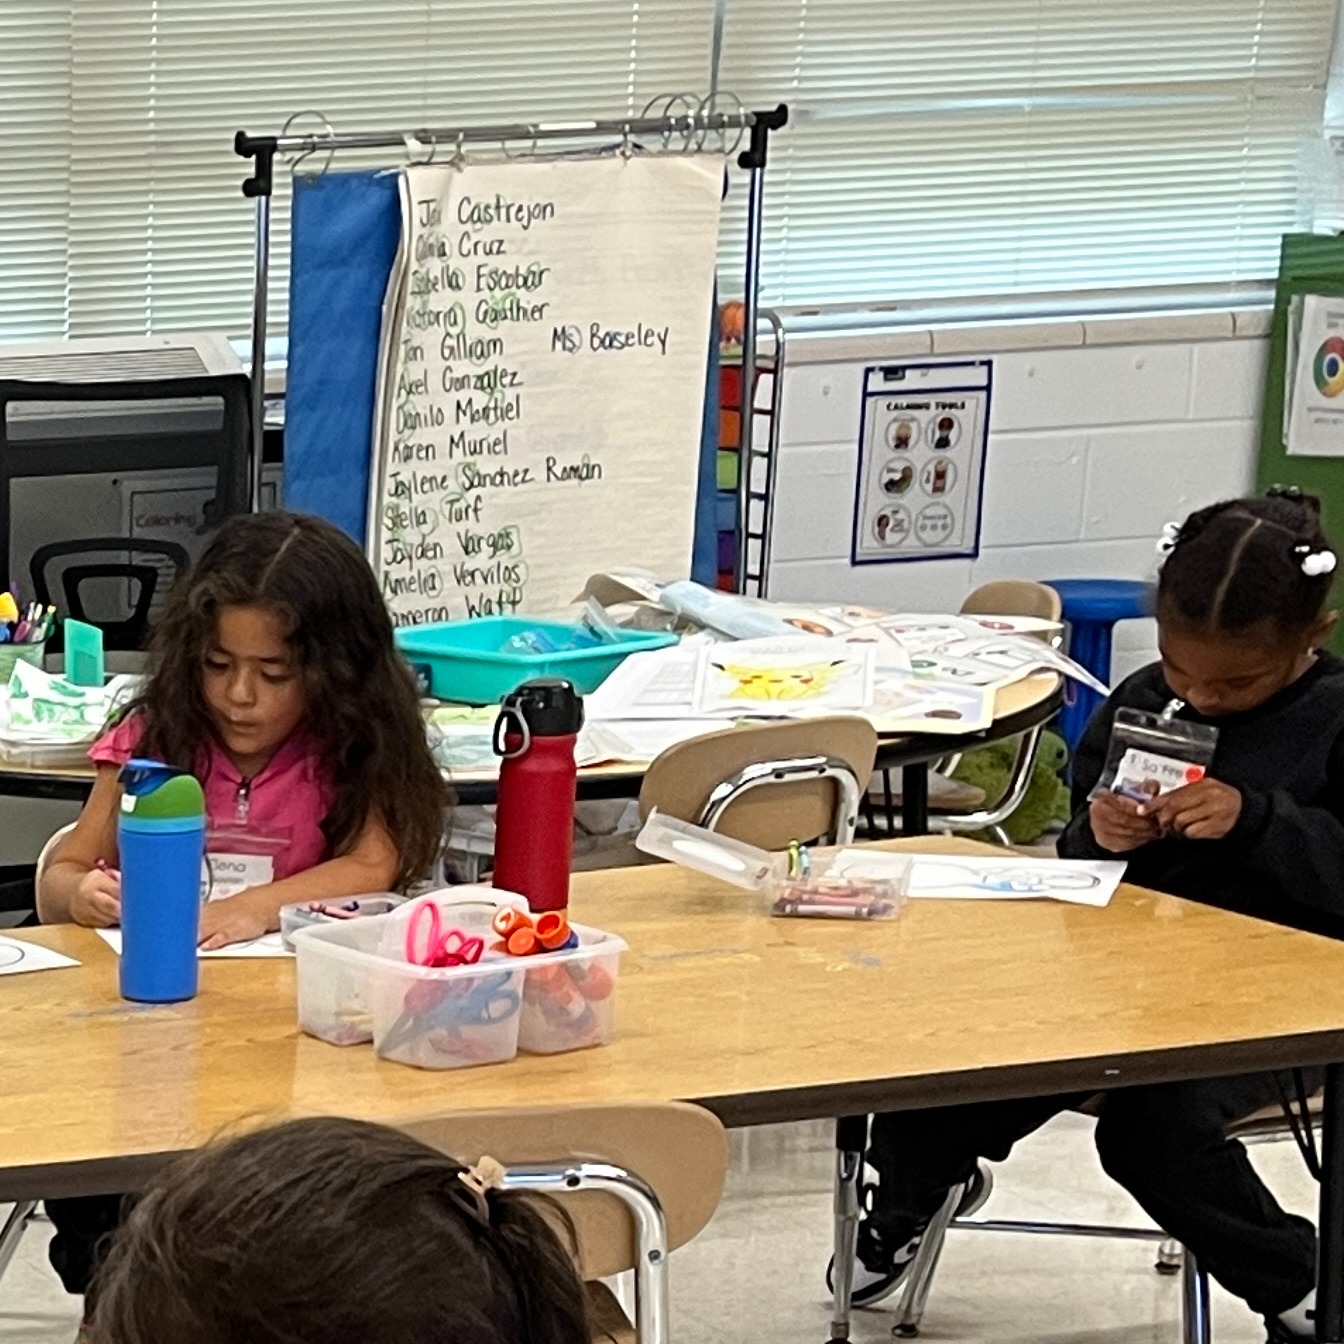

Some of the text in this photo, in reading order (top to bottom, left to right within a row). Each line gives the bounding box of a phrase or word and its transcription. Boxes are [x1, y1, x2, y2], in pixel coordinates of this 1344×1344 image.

[458, 231, 507, 258] Cruz
[590, 322, 670, 356] Baseley
[457, 528, 515, 560] Vargas
[391, 605, 449, 628] ameron
